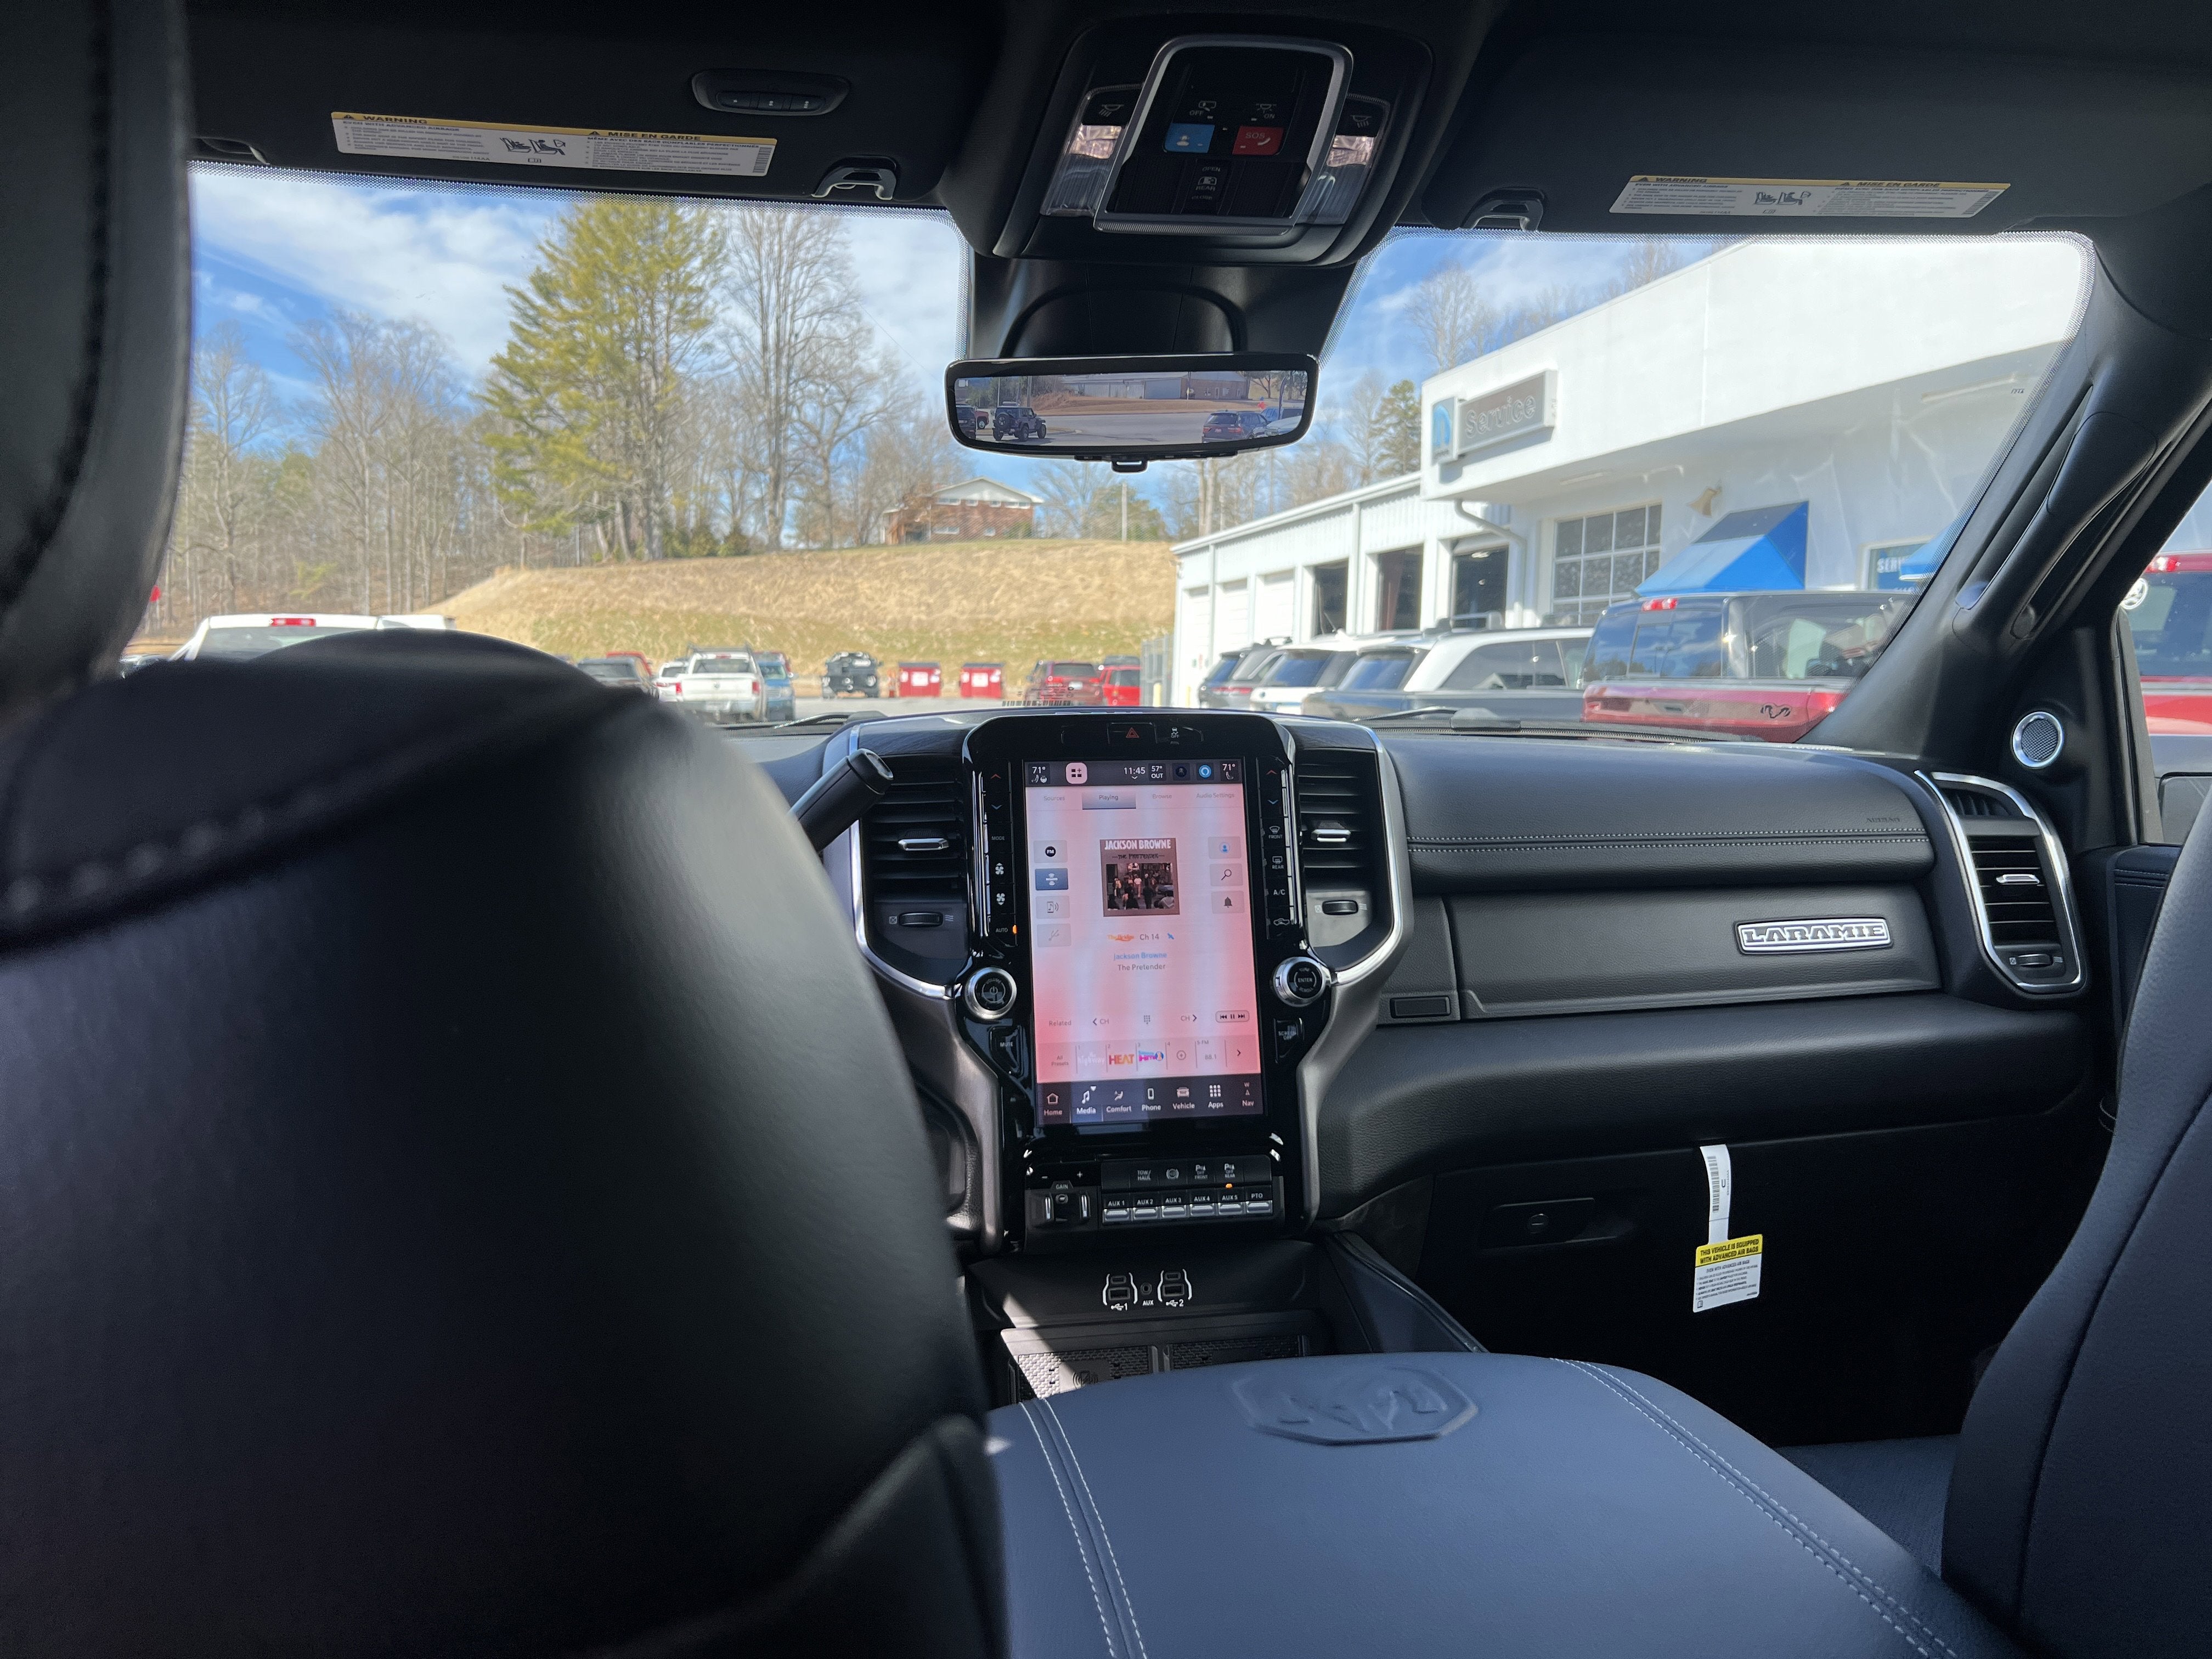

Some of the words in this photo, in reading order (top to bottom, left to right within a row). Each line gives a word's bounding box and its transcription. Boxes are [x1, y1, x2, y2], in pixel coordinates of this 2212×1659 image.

[363, 115, 427, 124] WARNING
[1464, 395, 1537, 440] Service
[1124, 766, 1146, 775] 11:45
[1104, 840, 1138, 850] JACKSON
[1138, 839, 1171, 849] BROWNE
[1743, 923, 1886, 944] LARAMIE
[1113, 952, 1139, 961] Jackson
[1109, 1054, 1135, 1065] HEAT
[1106, 1105, 1132, 1113] Comfort
[1711, 1244, 1731, 1254] VEHICLE
[1736, 1239, 1759, 1249] EQUIPPED
[1700, 1256, 1712, 1264] WITH
[1712, 1251, 1737, 1261] ADVANCED
[1746, 1246, 1758, 1254] BAGS
